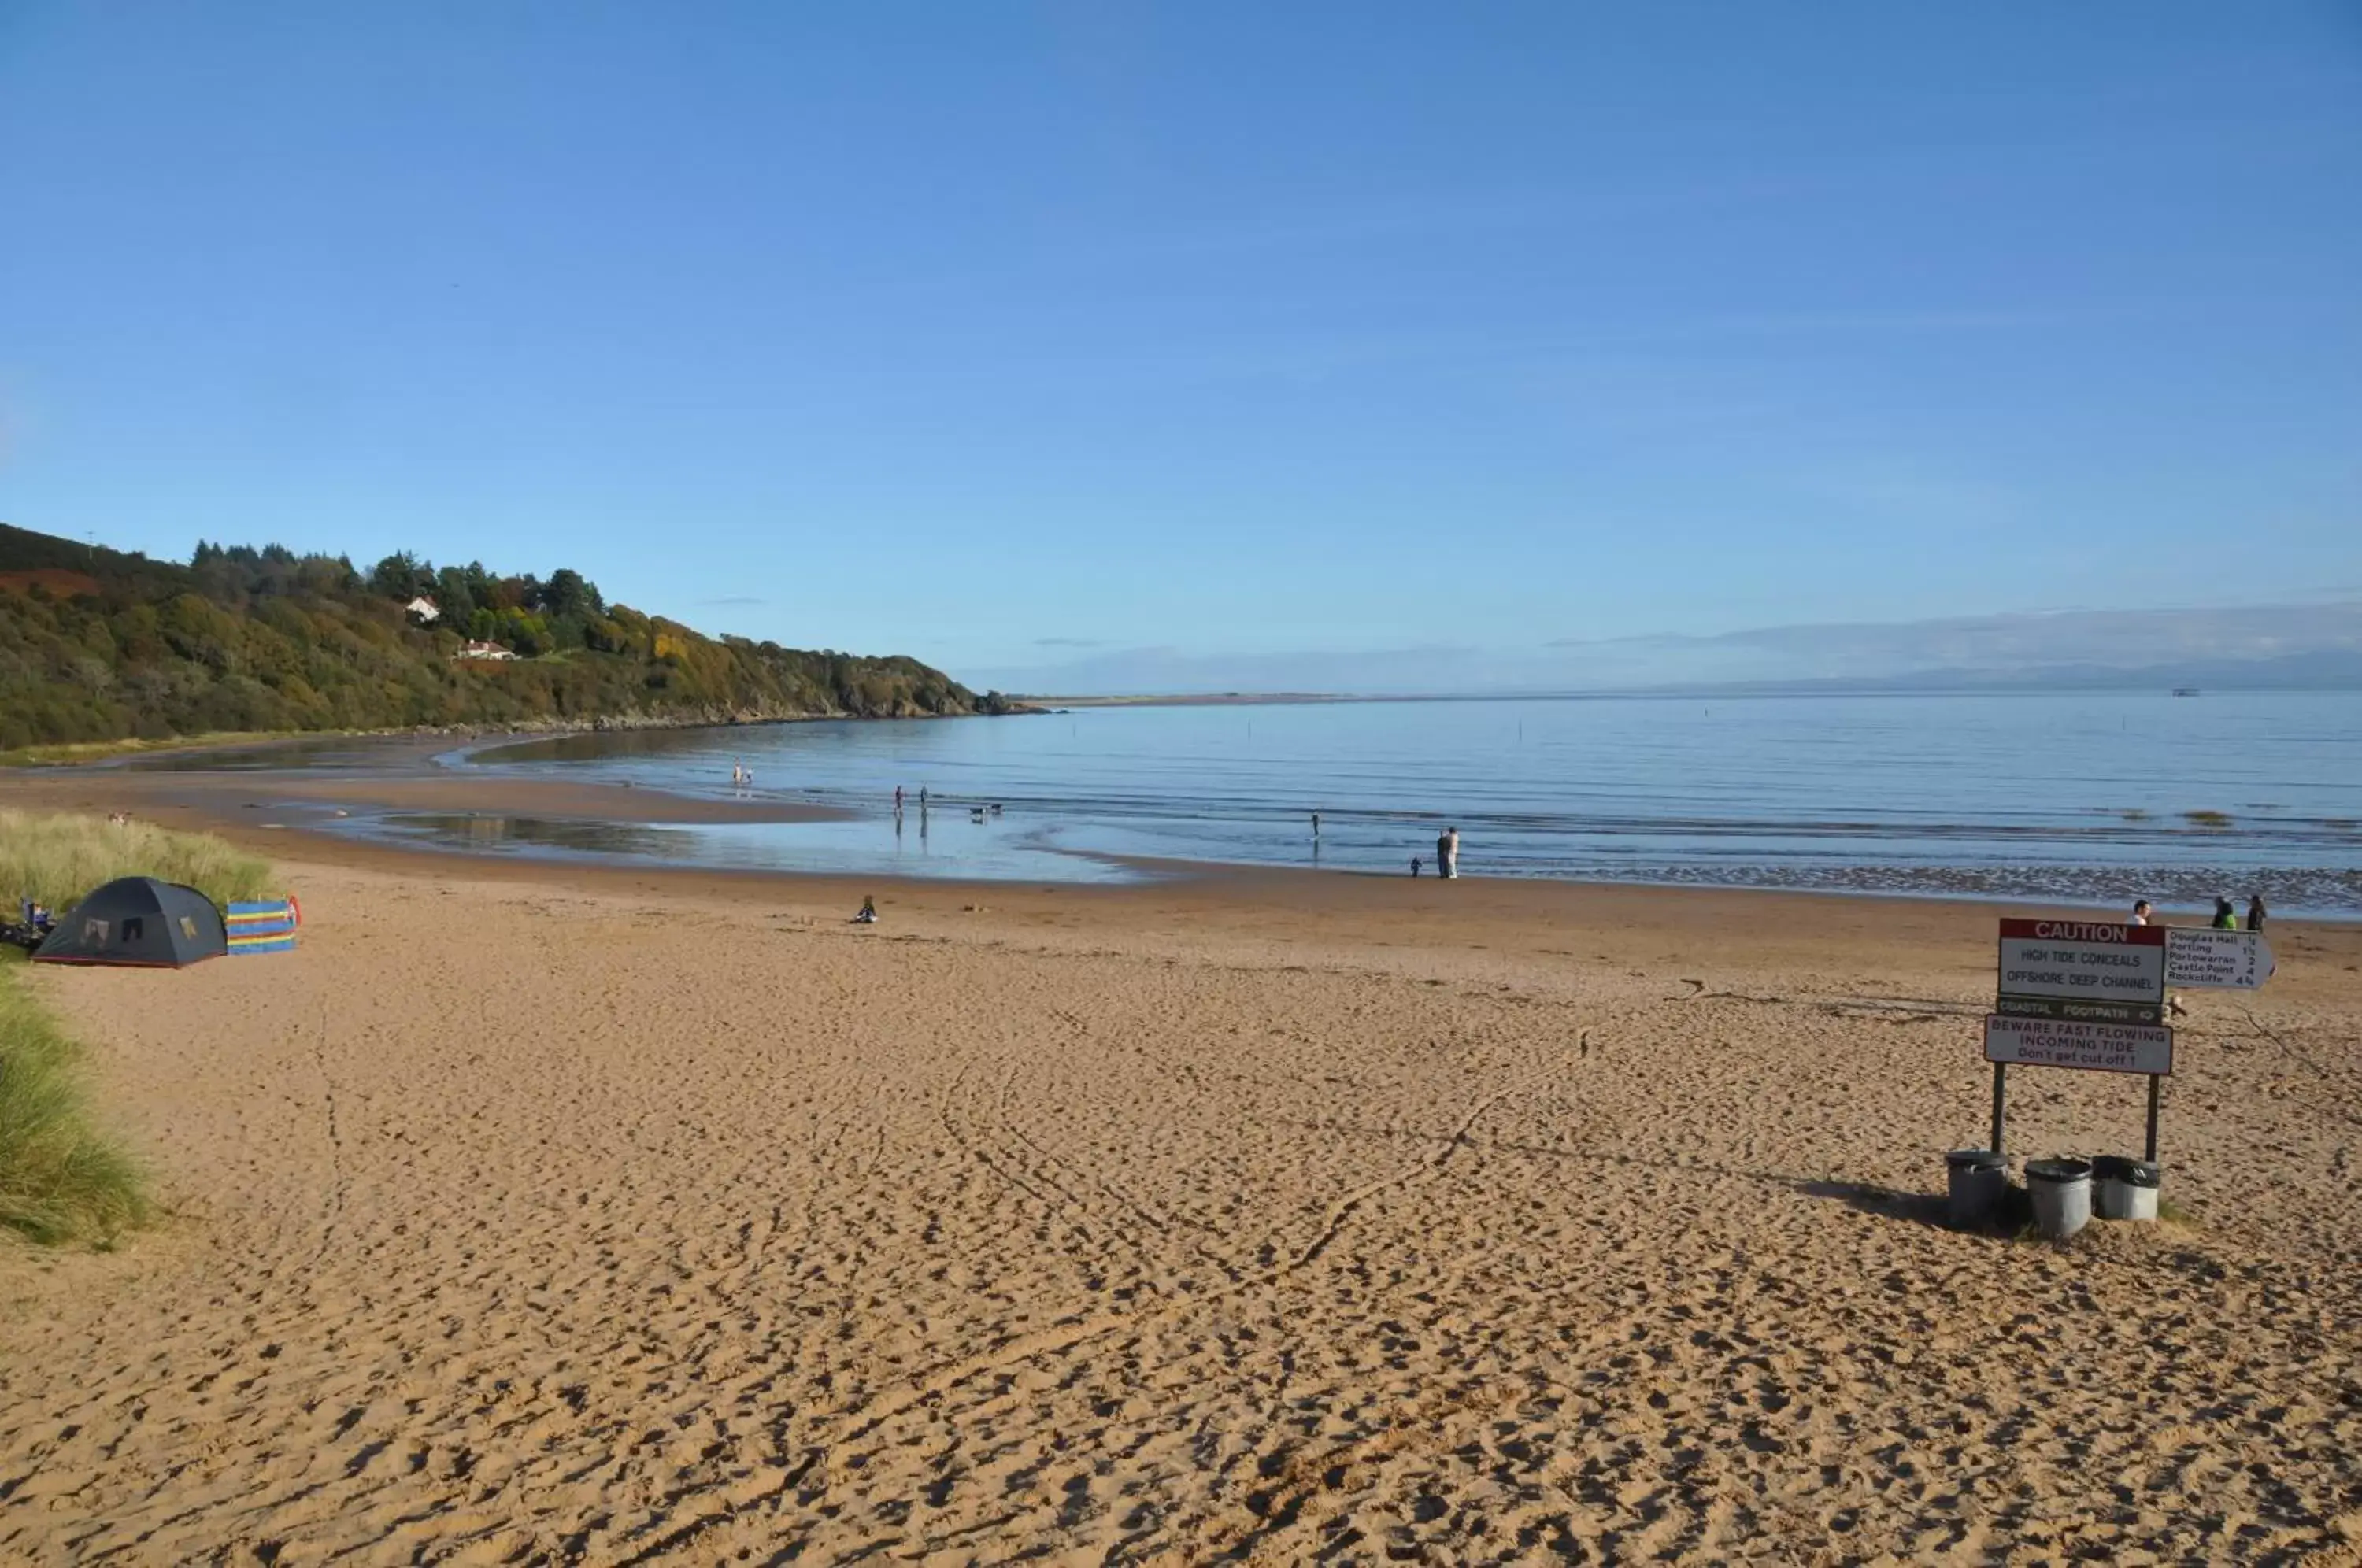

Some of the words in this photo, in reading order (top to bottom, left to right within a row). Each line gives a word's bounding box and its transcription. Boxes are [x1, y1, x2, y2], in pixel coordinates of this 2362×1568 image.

[2035, 923, 2127, 942] CAUTION
[2170, 931, 2212, 943] Douglas
[2216, 934, 2238, 944] Hall
[2021, 949, 2047, 962] HIGH
[2053, 951, 2075, 963] TIDE
[2081, 952, 2141, 967] CONCEALS
[2249, 956, 2255, 966] 2
[2170, 961, 2205, 971] Castle
[2207, 964, 2234, 974] Point
[2007, 971, 2064, 985] OFFSHORE
[2069, 974, 2098, 986] DEEP
[2102, 976, 2154, 989] CHANNEL
[2001, 1002, 2051, 1014] COASTAL
[2064, 1005, 2128, 1019] FOOTPATH
[1992, 1019, 2051, 1033] BEWARE
[2057, 1024, 2090, 1037] FAST
[2097, 1027, 2165, 1042] FLOWING
[2020, 1034, 2096, 1049] INCOMING
[2102, 1041, 2134, 1052] TIDE
[2018, 1048, 2051, 1060] Don't
[2056, 1050, 2077, 1063] get
[2081, 1052, 2103, 1063] cut
[2106, 1054, 2126, 1065] off
